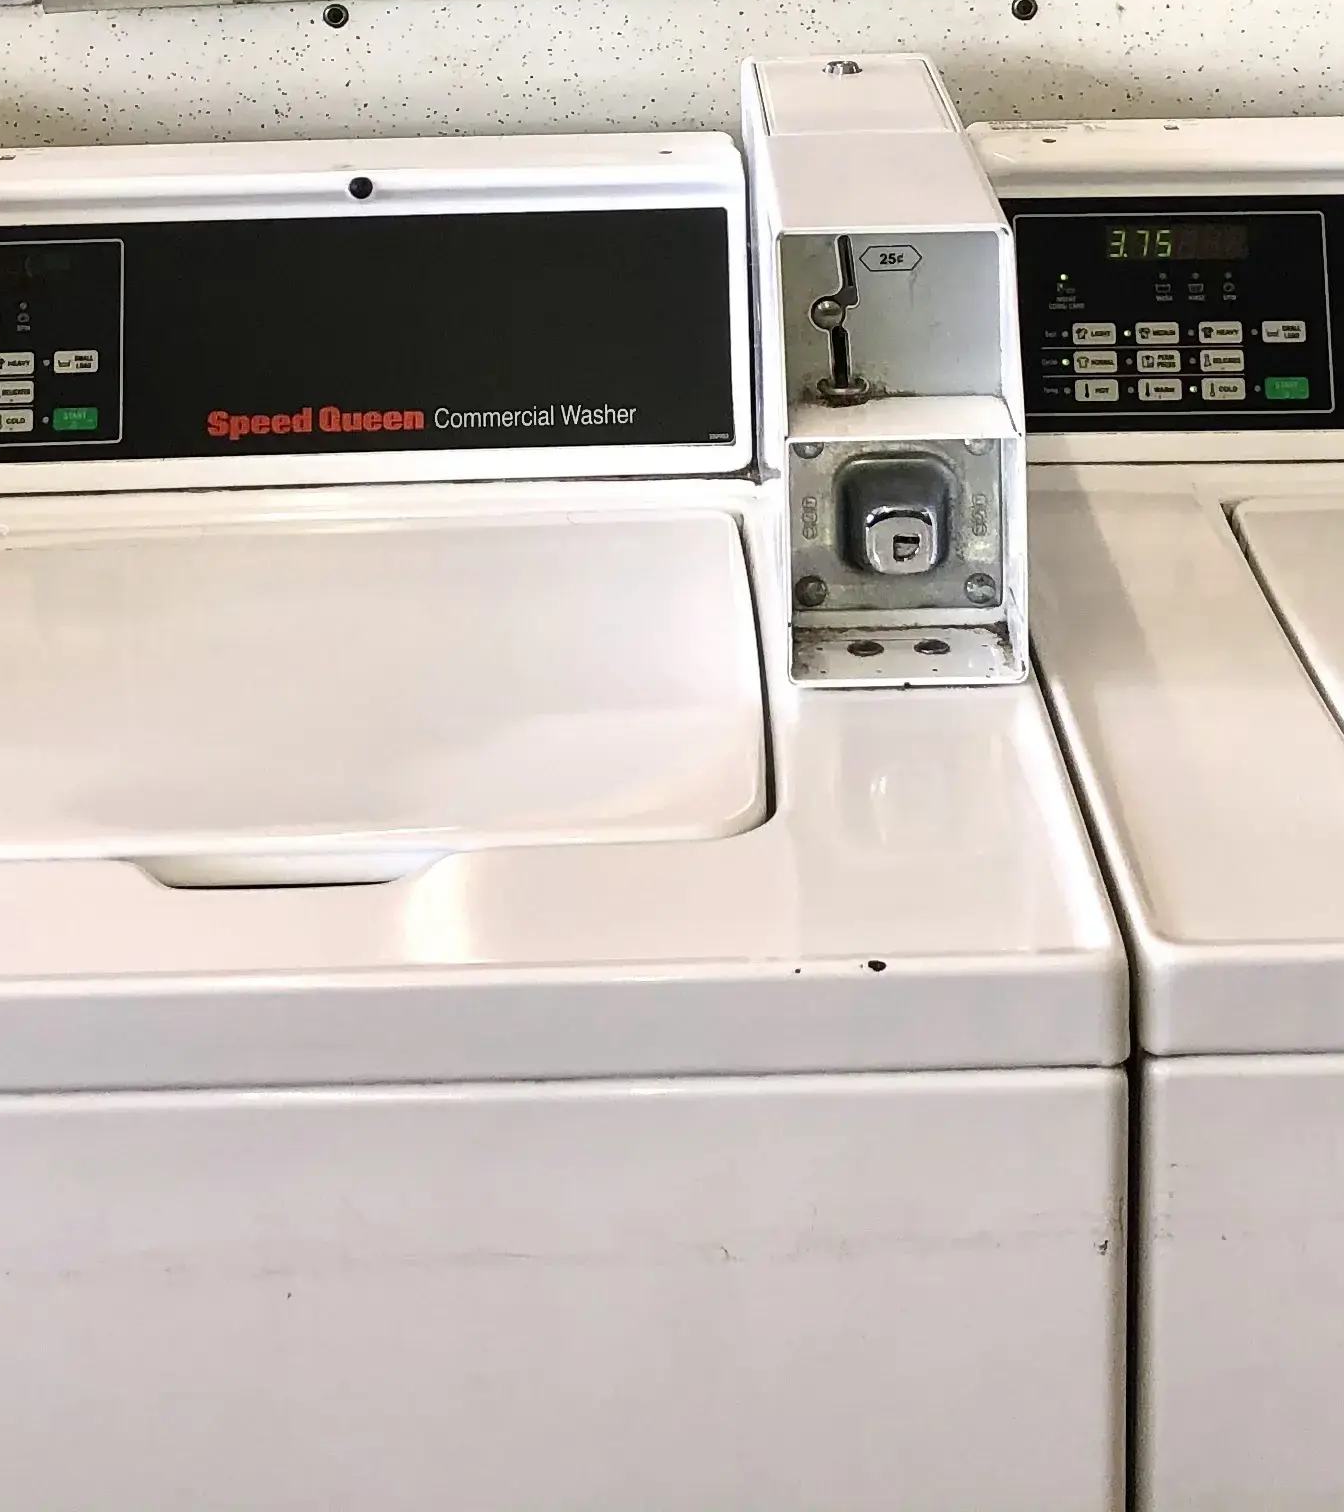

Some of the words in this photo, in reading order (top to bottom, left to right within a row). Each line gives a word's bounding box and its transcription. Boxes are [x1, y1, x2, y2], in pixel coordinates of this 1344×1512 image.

[1108, 229, 1173, 258] 3.75
[879, 252, 904, 265] 25¢
[207, 407, 313, 440] Speed
[319, 406, 424, 432] Queen
[434, 405, 555, 429] Commercial
[560, 404, 637, 426] Washer
